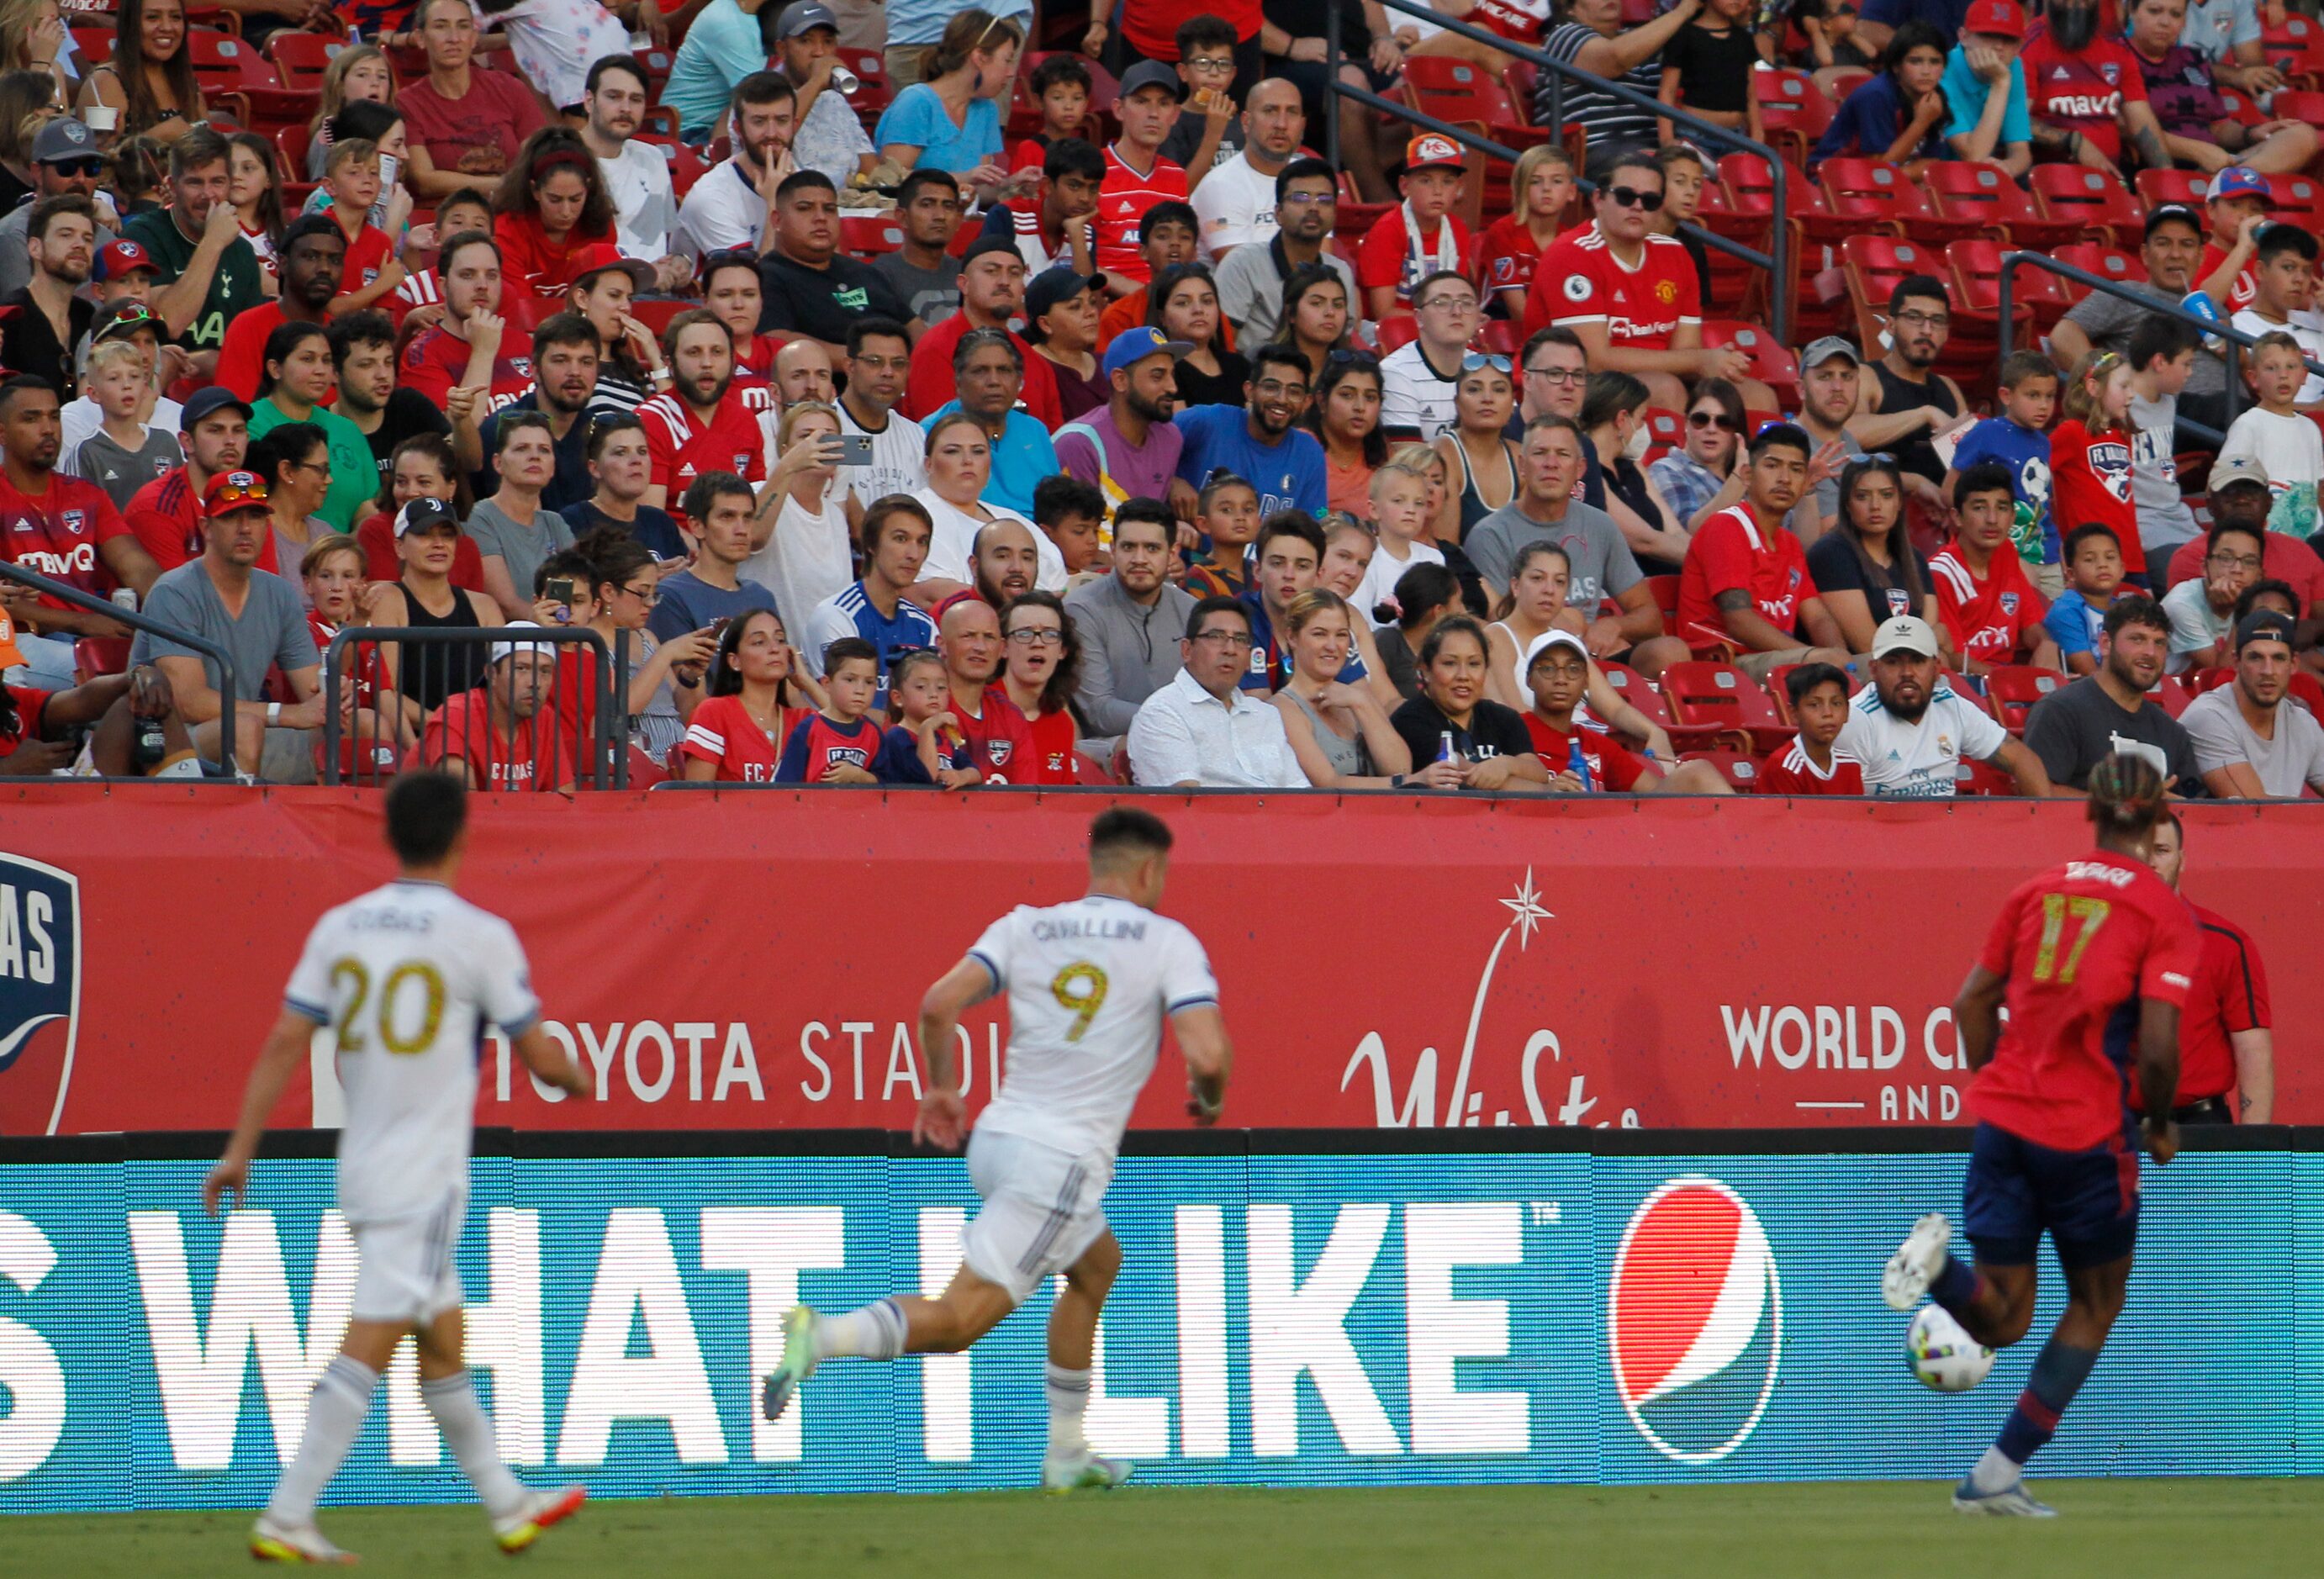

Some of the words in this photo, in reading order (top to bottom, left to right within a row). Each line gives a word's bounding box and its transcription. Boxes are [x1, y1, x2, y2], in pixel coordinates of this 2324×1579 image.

[2032, 893, 2110, 984] 17
[329, 957, 446, 1055] 20
[1051, 960, 1108, 1043] 9
[1719, 1006, 1906, 1071] WORLD
[484, 1020, 765, 1102] TOYOTA
[800, 1021, 999, 1101] STADI
[1880, 1085, 1961, 1121] AND
[128, 1207, 845, 1471] WHAT
[918, 1207, 973, 1462] I
